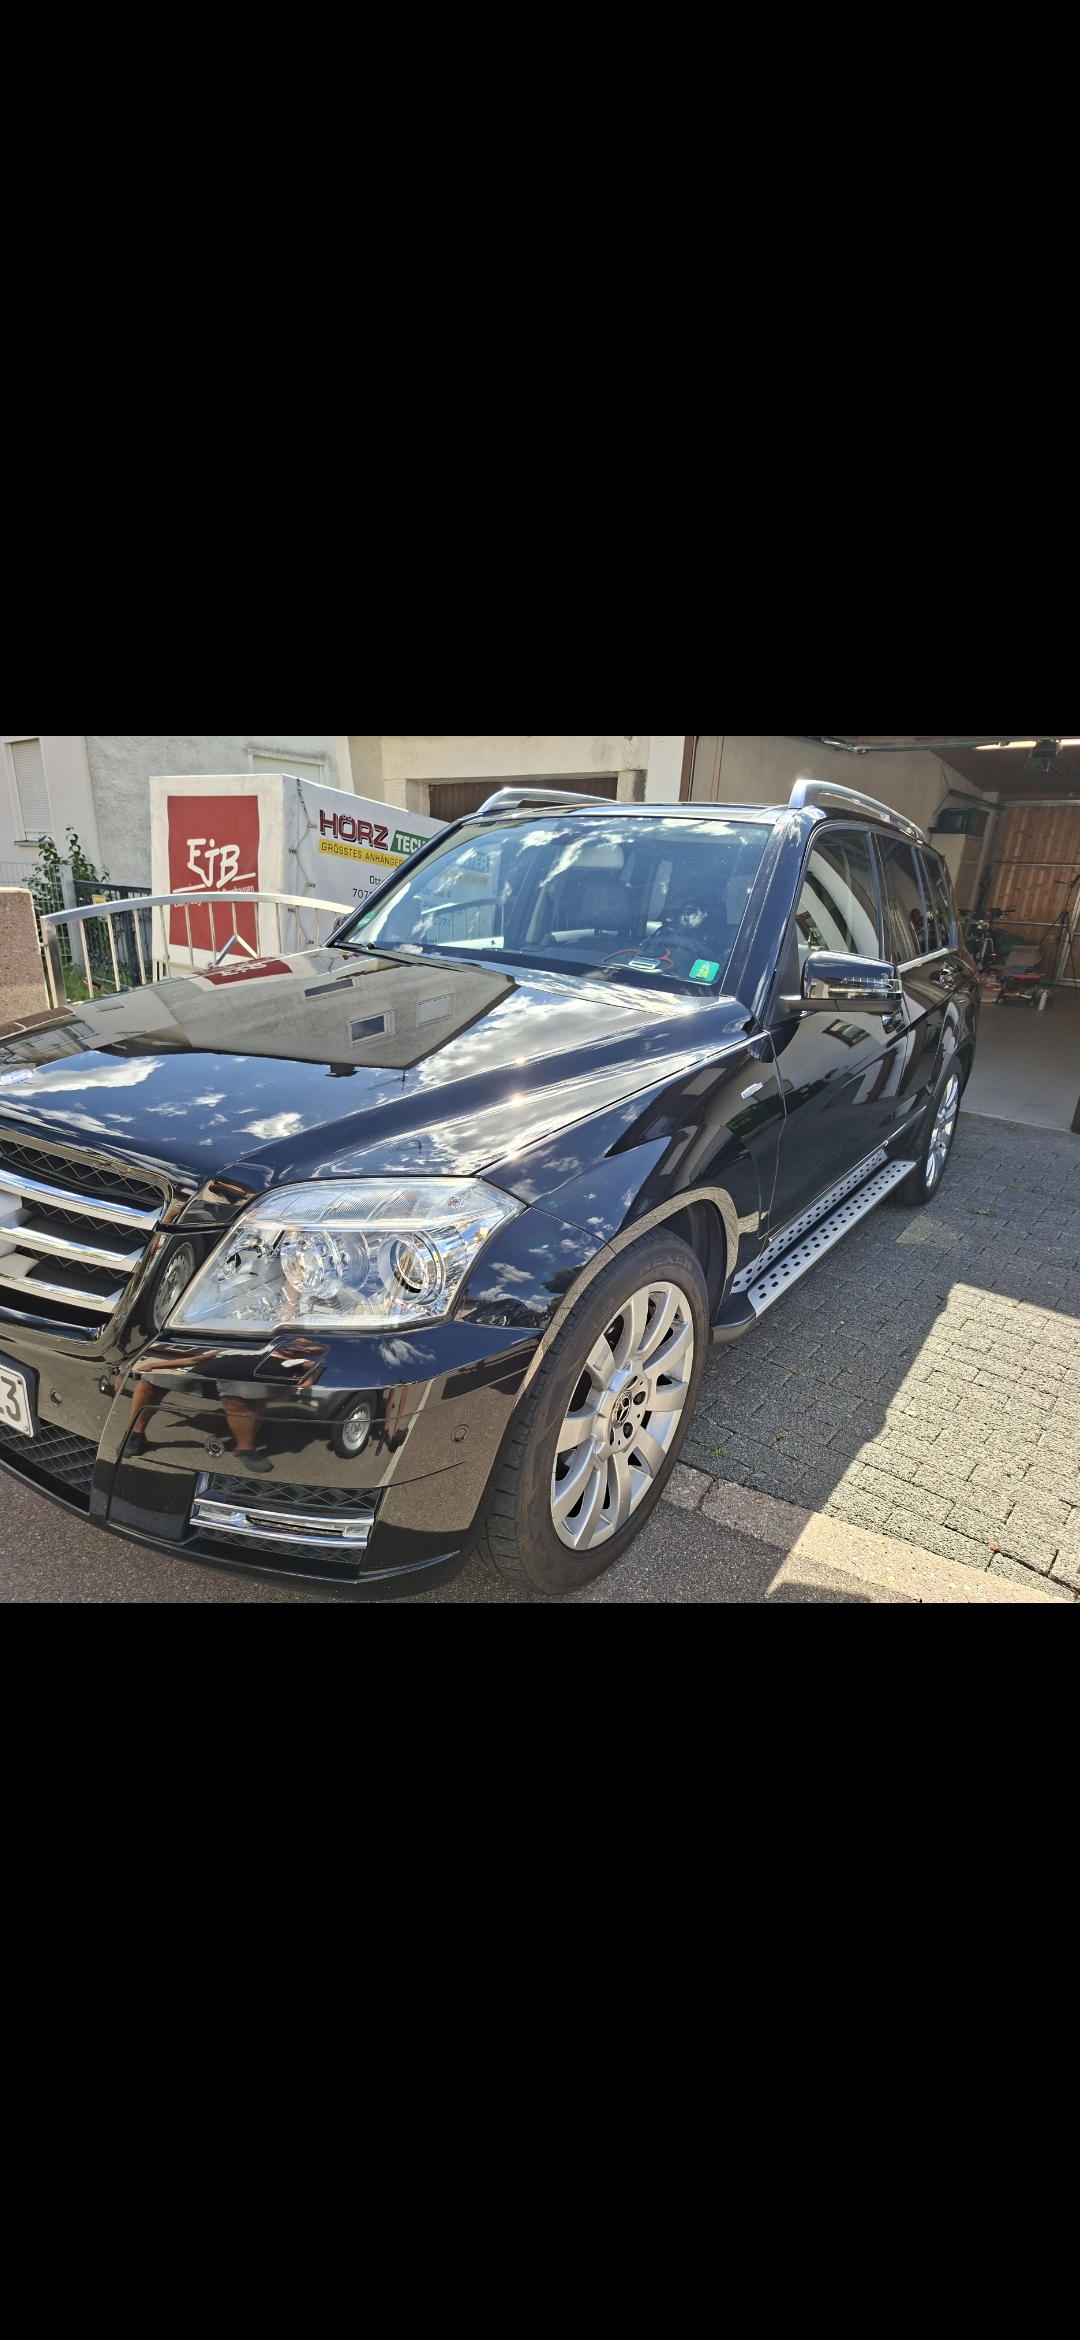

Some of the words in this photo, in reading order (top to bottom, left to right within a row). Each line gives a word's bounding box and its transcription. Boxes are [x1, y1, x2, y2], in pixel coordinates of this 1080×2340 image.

[319, 809, 389, 851] HÖRZ
[321, 842, 362, 859] GRÖSSTES
[352, 888, 372, 899] 707
[0, 1375, 21, 1422] 3
